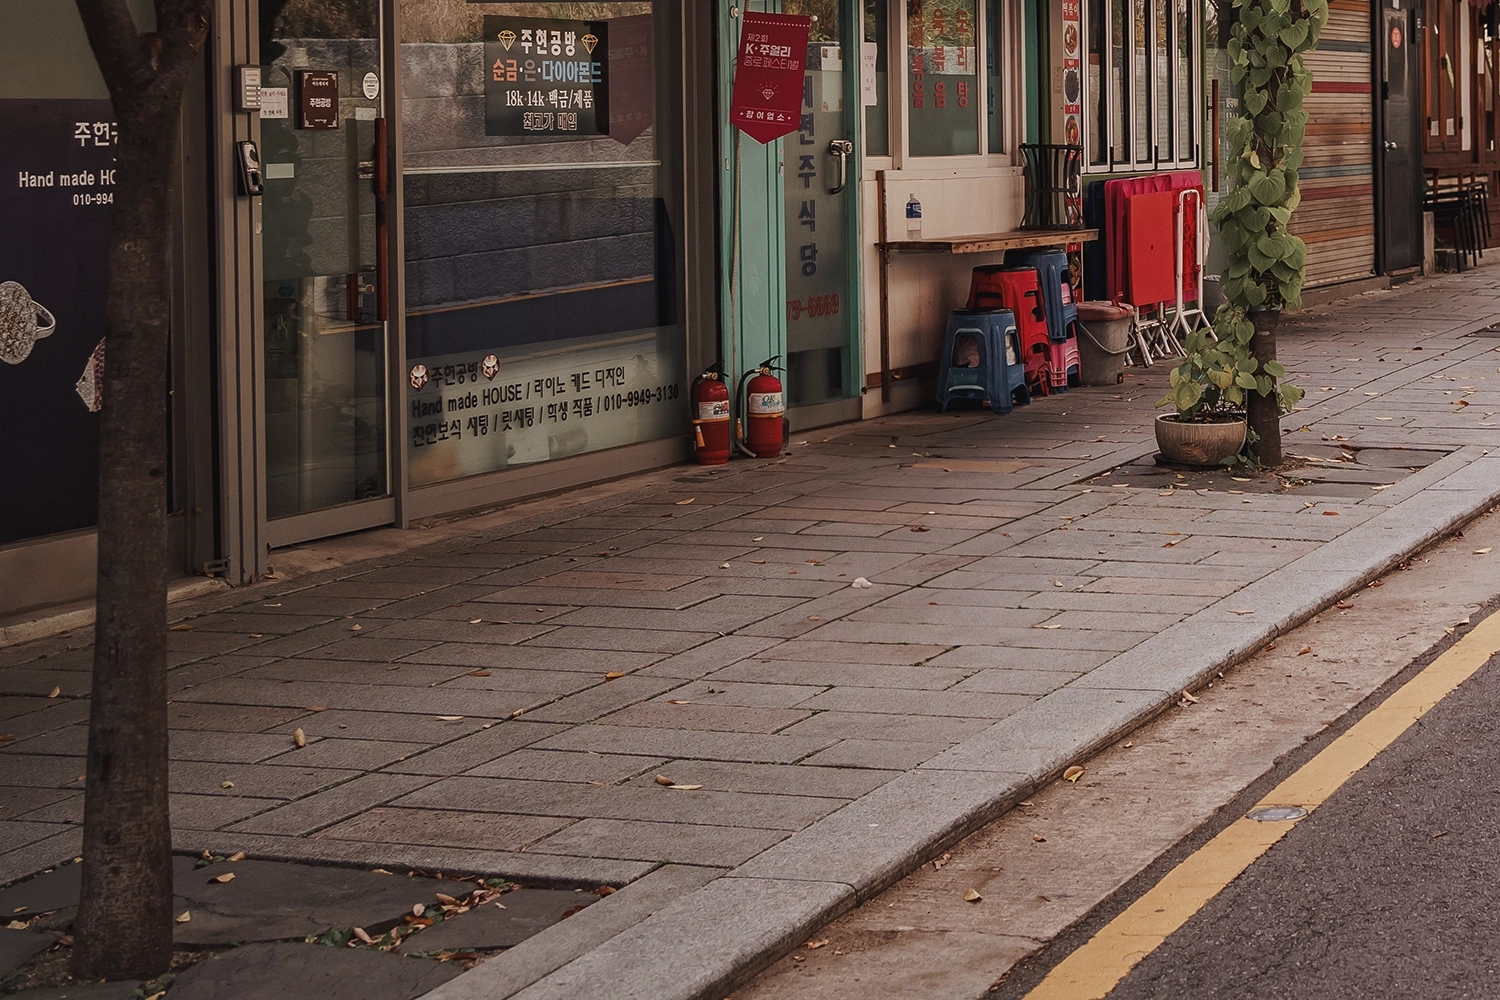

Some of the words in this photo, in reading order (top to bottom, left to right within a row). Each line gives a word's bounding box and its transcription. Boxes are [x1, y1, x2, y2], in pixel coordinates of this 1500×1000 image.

[521, 28, 577, 57] 주현공방
[746, 33, 769, 43] 제2회
[309, 97, 332, 108] 주현공방
[523, 112, 555, 131] 최고가
[557, 112, 578, 131] 매입
[745, 110, 785, 122] 참여업소
[19, 170, 54, 188] Hand
[59, 169, 95, 187] made
[73, 192, 114, 206] 010-994
[431, 361, 479, 388] 주현공방
[412, 396, 443, 418] Hand
[448, 391, 478, 412] made
[482, 383, 522, 405] HOUSE
[526, 381, 532, 400] /
[534, 377, 566, 398] 라이노
[595, 366, 625, 389] 디자인
[413, 418, 462, 447] 천연보석
[494, 413, 499, 432] /
[539, 405, 544, 424] /
[547, 401, 568, 423] 학생
[572, 397, 593, 419] 작품
[596, 396, 601, 414] /
